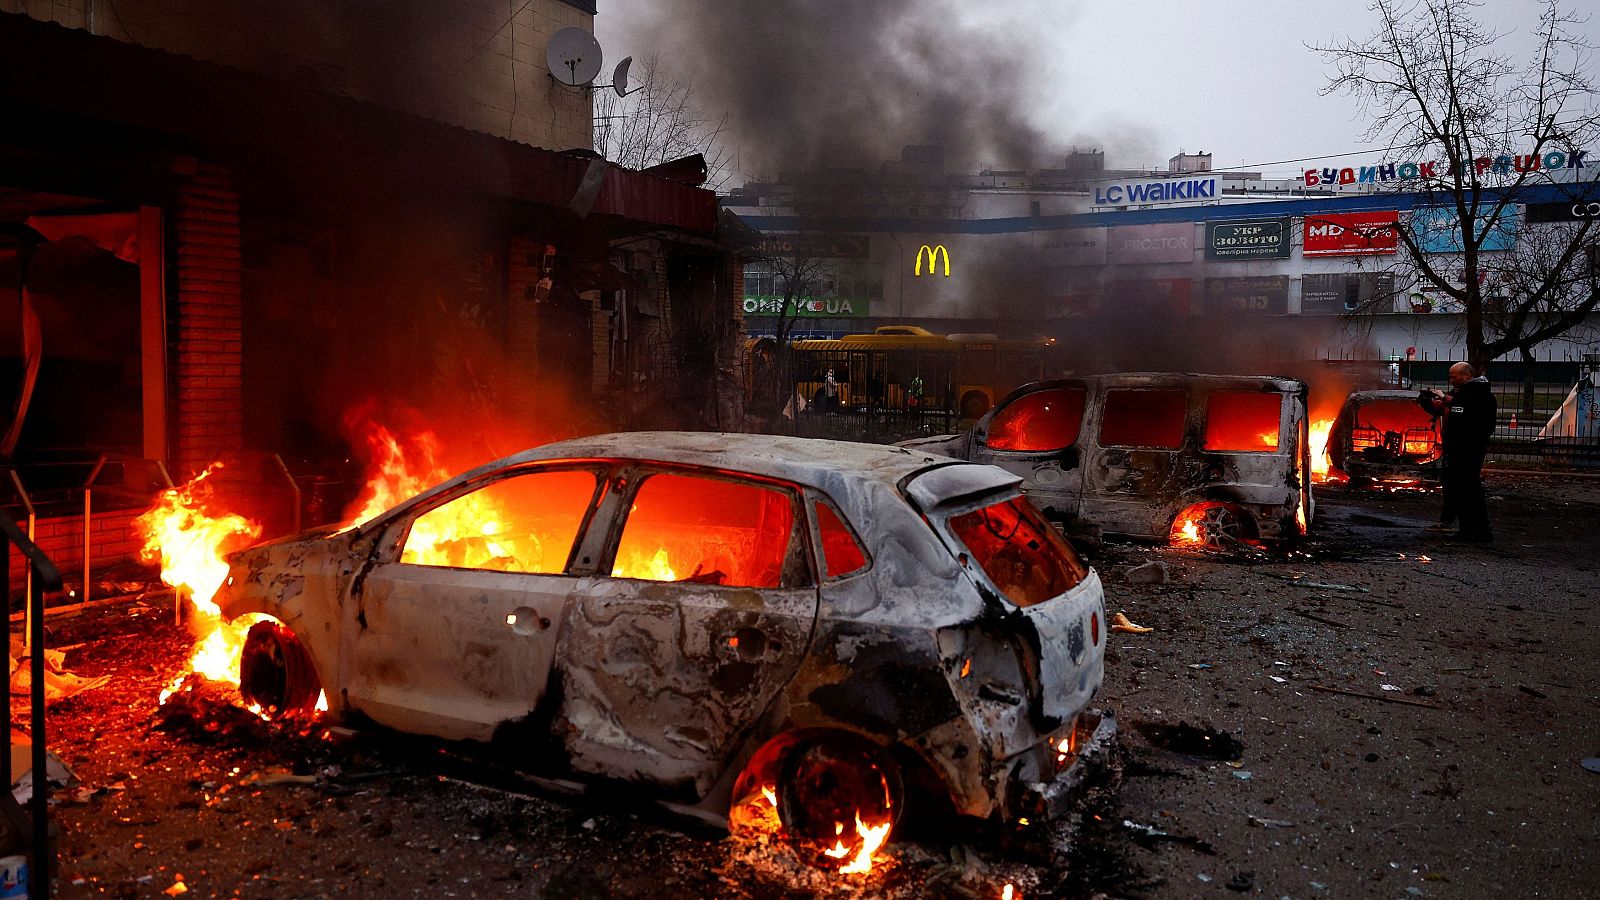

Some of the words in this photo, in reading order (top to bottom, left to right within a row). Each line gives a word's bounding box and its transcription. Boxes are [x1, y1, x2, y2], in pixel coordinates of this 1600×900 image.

[1304, 160, 1437, 187] БУДИНОК
[1447, 150, 1587, 177] РАШОК
[1095, 185, 1123, 205] LC
[1233, 227, 1262, 235] УКР
[1309, 224, 1345, 237] MD
[1124, 236, 1188, 250] PROSTOR
[1216, 236, 1279, 246] ЗОЛОТО
